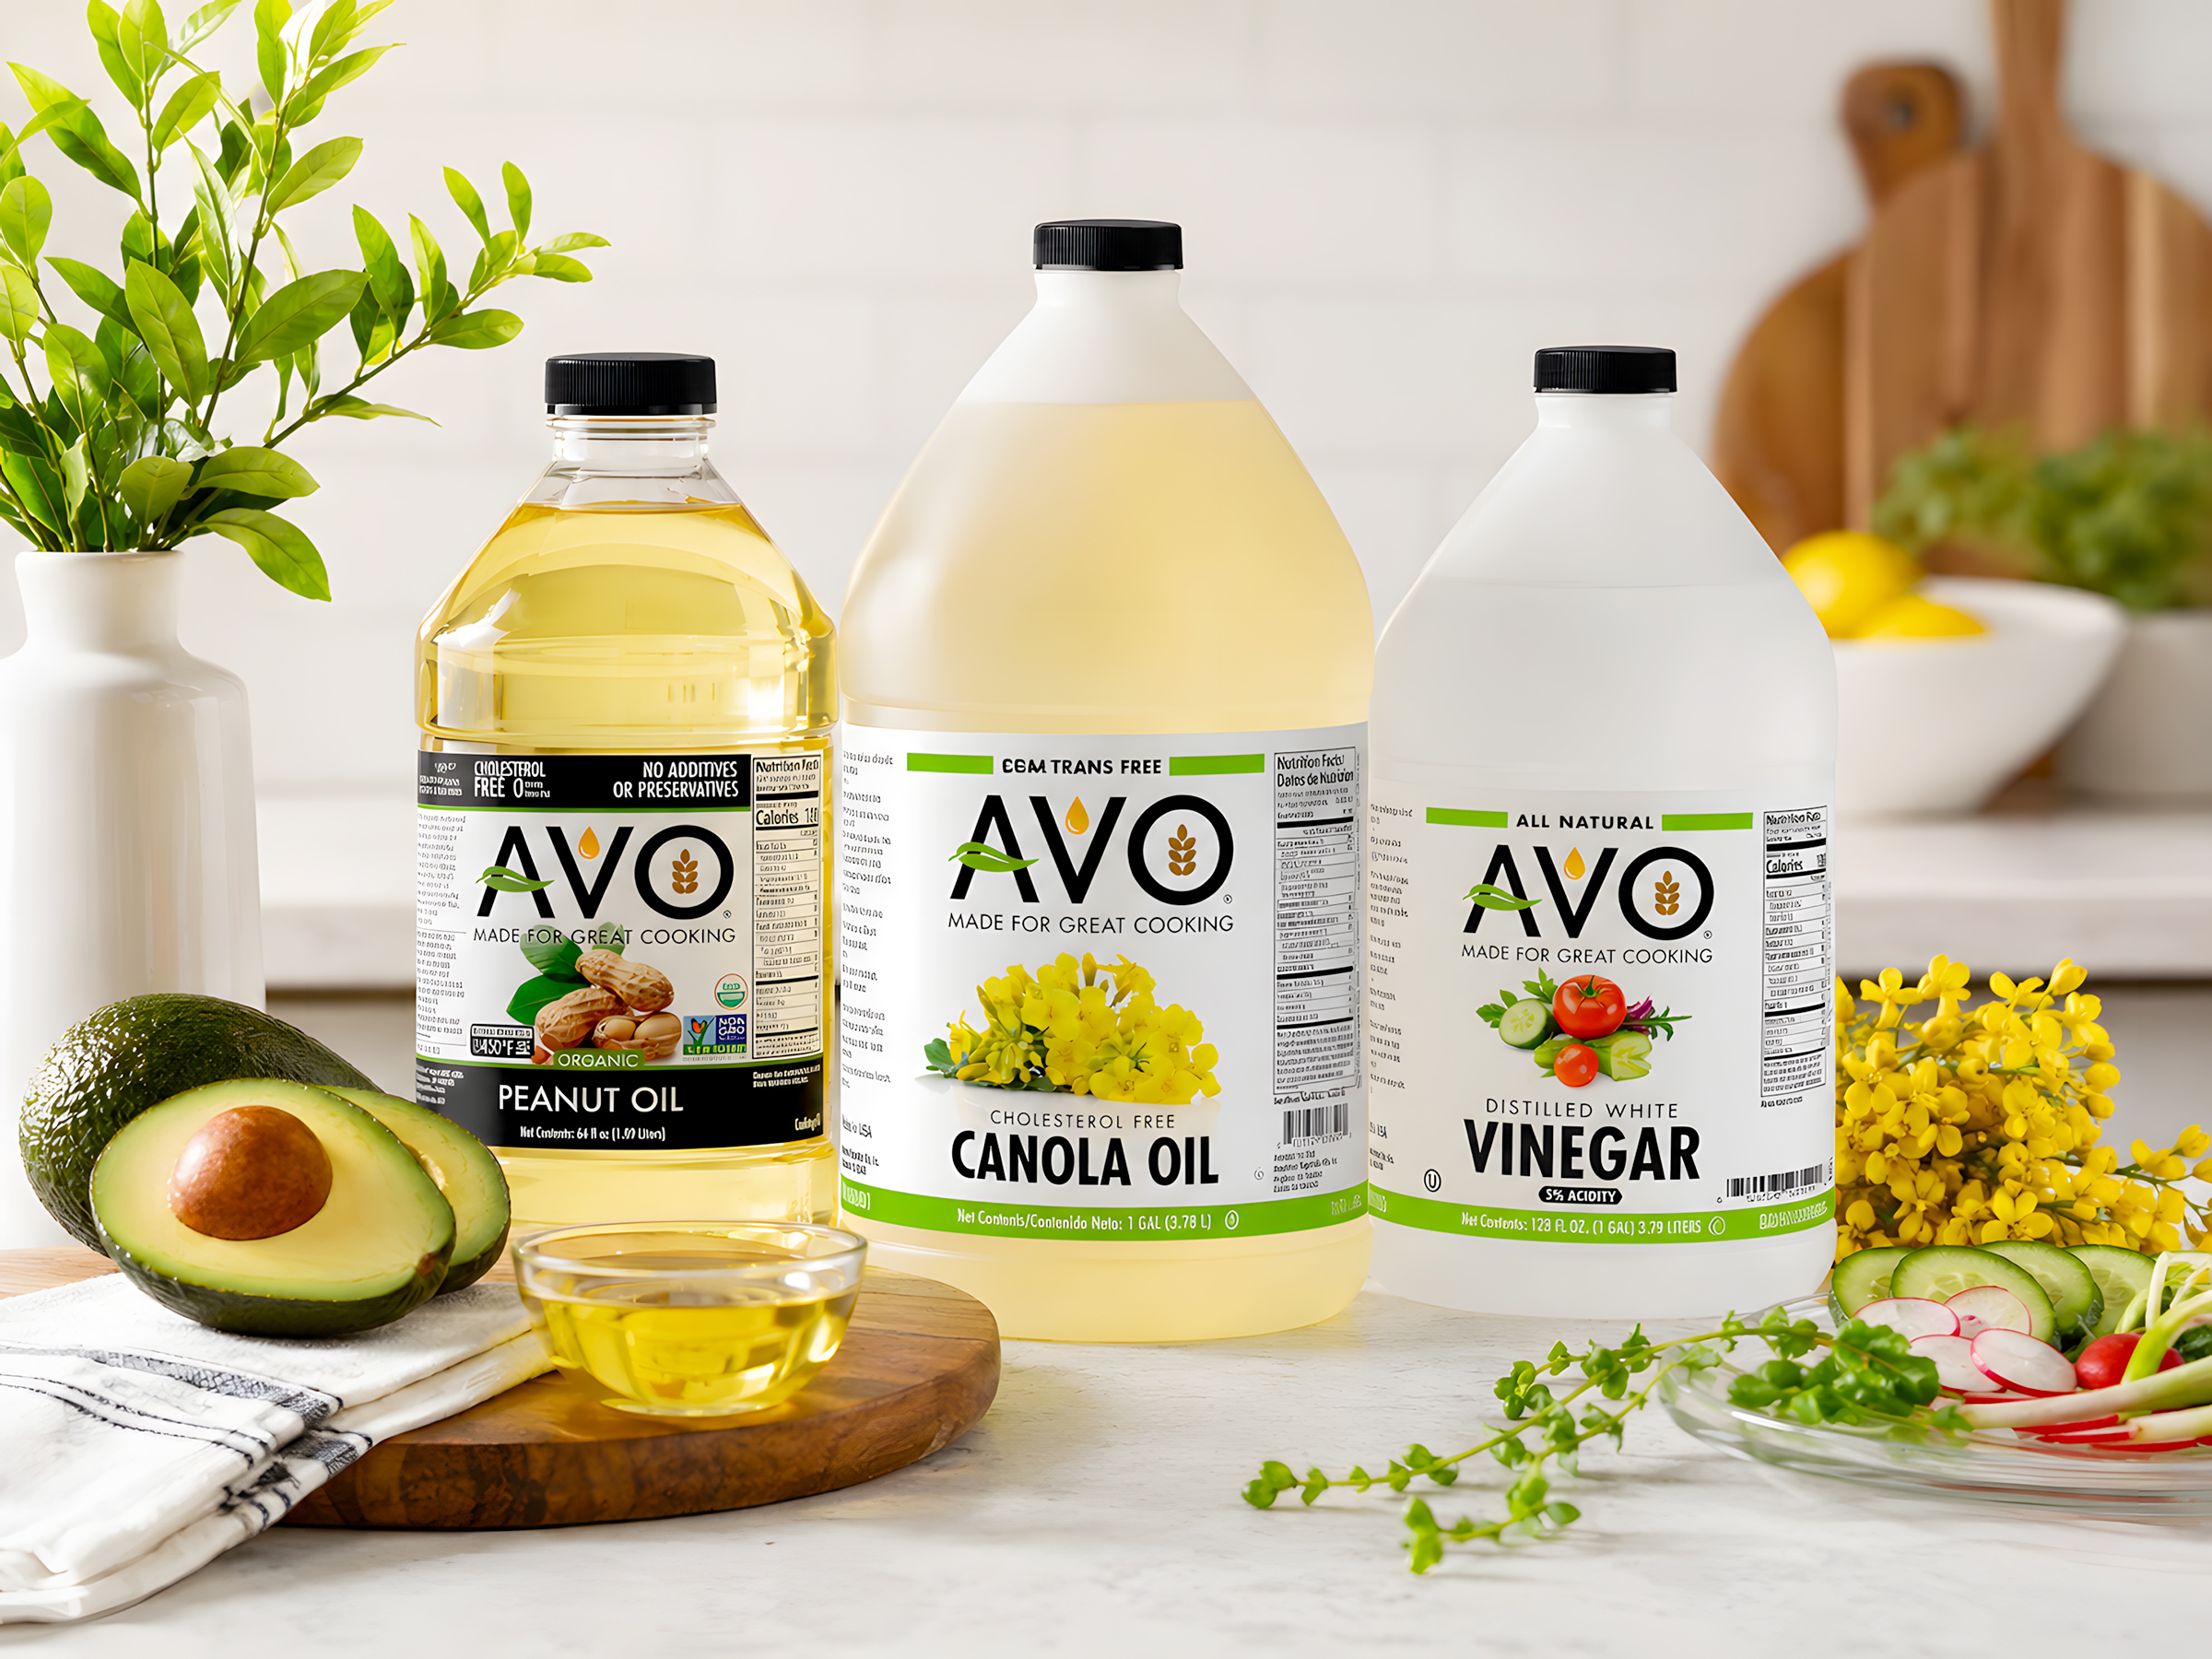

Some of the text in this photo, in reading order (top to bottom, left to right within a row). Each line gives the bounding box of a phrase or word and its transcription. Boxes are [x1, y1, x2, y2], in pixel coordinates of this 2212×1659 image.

[642, 760, 664, 779] NO
[1050, 759, 1113, 775] TRANS
[1121, 759, 1161, 774] FREE
[474, 777, 506, 797] FREE
[613, 781, 633, 798] OR
[638, 780, 739, 798] PRESERVATIVES
[1515, 814, 1655, 830] ALL NATURAL
[948, 794, 1234, 906] AVO
[476, 824, 735, 920] AVO
[1462, 843, 1715, 941] AVO
[947, 912, 1234, 934] MADE FOR GREAT COOKING
[473, 927, 735, 945] MADE FOR GREAT COOKING
[1461, 944, 1713, 964] MADE FOR GREAT COOKING
[558, 1053, 639, 1068] ORGANIC
[499, 1084, 684, 1112] PEANUT OIL
[1486, 1098, 1678, 1119] DISTILLED WHITE
[990, 1110, 1176, 1129] CHOLESTEROL FREE
[951, 1129, 1132, 1186] CANOLA
[1147, 1135, 1219, 1186] OIL
[1463, 1118, 1701, 1181] VINEGAR
[1567, 1190, 1618, 1203] ACIDITY
[1127, 1216, 1133, 1230] 1
[1137, 1215, 1161, 1230] GAL
[1200, 1213, 1212, 1230] L)
[1638, 1220, 1664, 1235] 3.79
